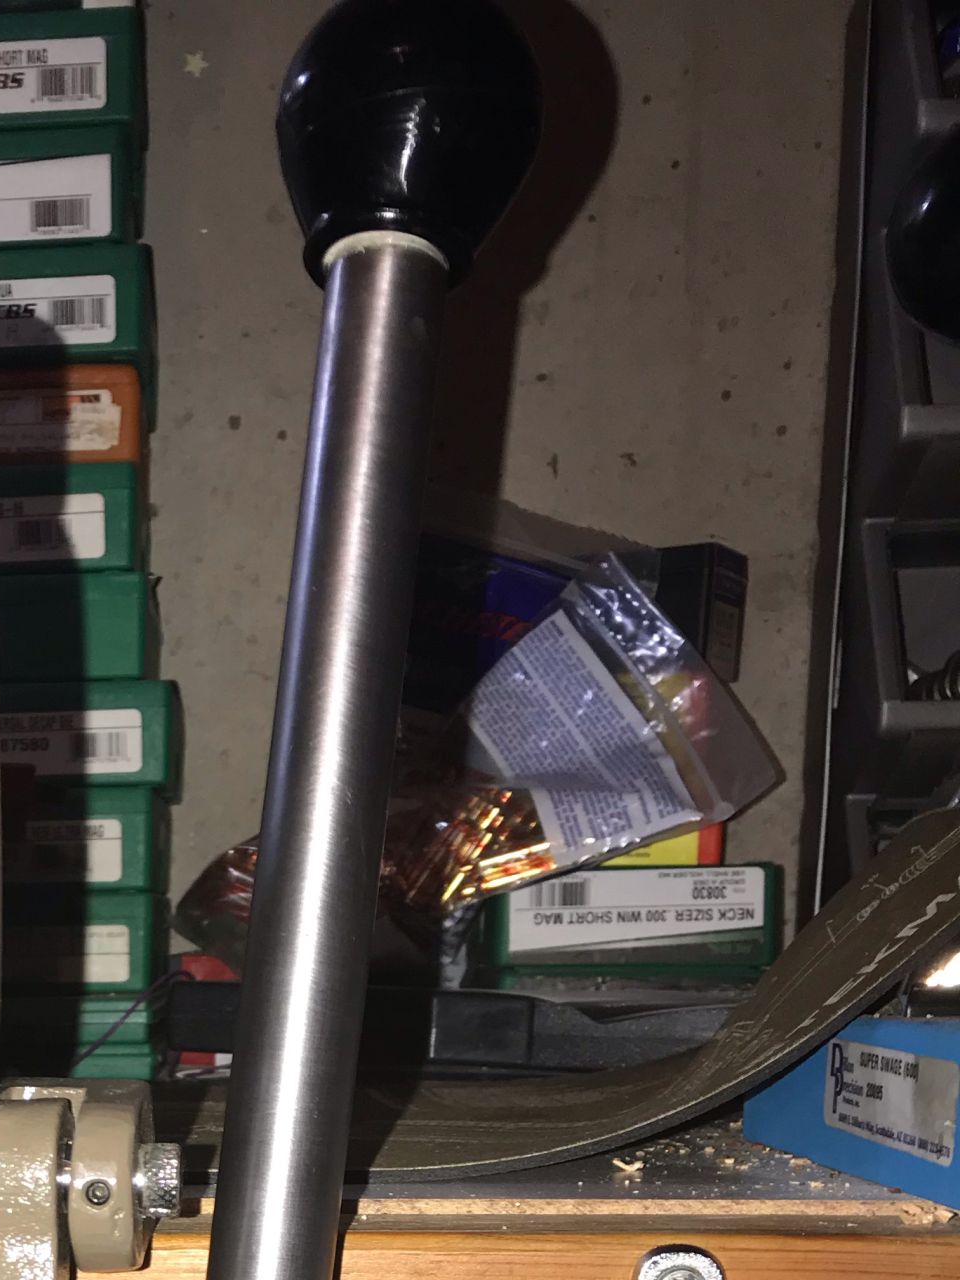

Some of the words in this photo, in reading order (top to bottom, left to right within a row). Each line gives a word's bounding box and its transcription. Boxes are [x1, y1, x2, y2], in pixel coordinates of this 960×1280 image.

[27, 48, 49, 64] MAG
[691, 885, 727, 900] 30830
[533, 912, 563, 926] MAG
[568, 910, 613, 924] SHORT
[616, 910, 640, 923] WIN
[675, 908, 713, 922] SIZER
[718, 907, 755, 921] NECK
[860, 1051, 880, 1070] SUPER
